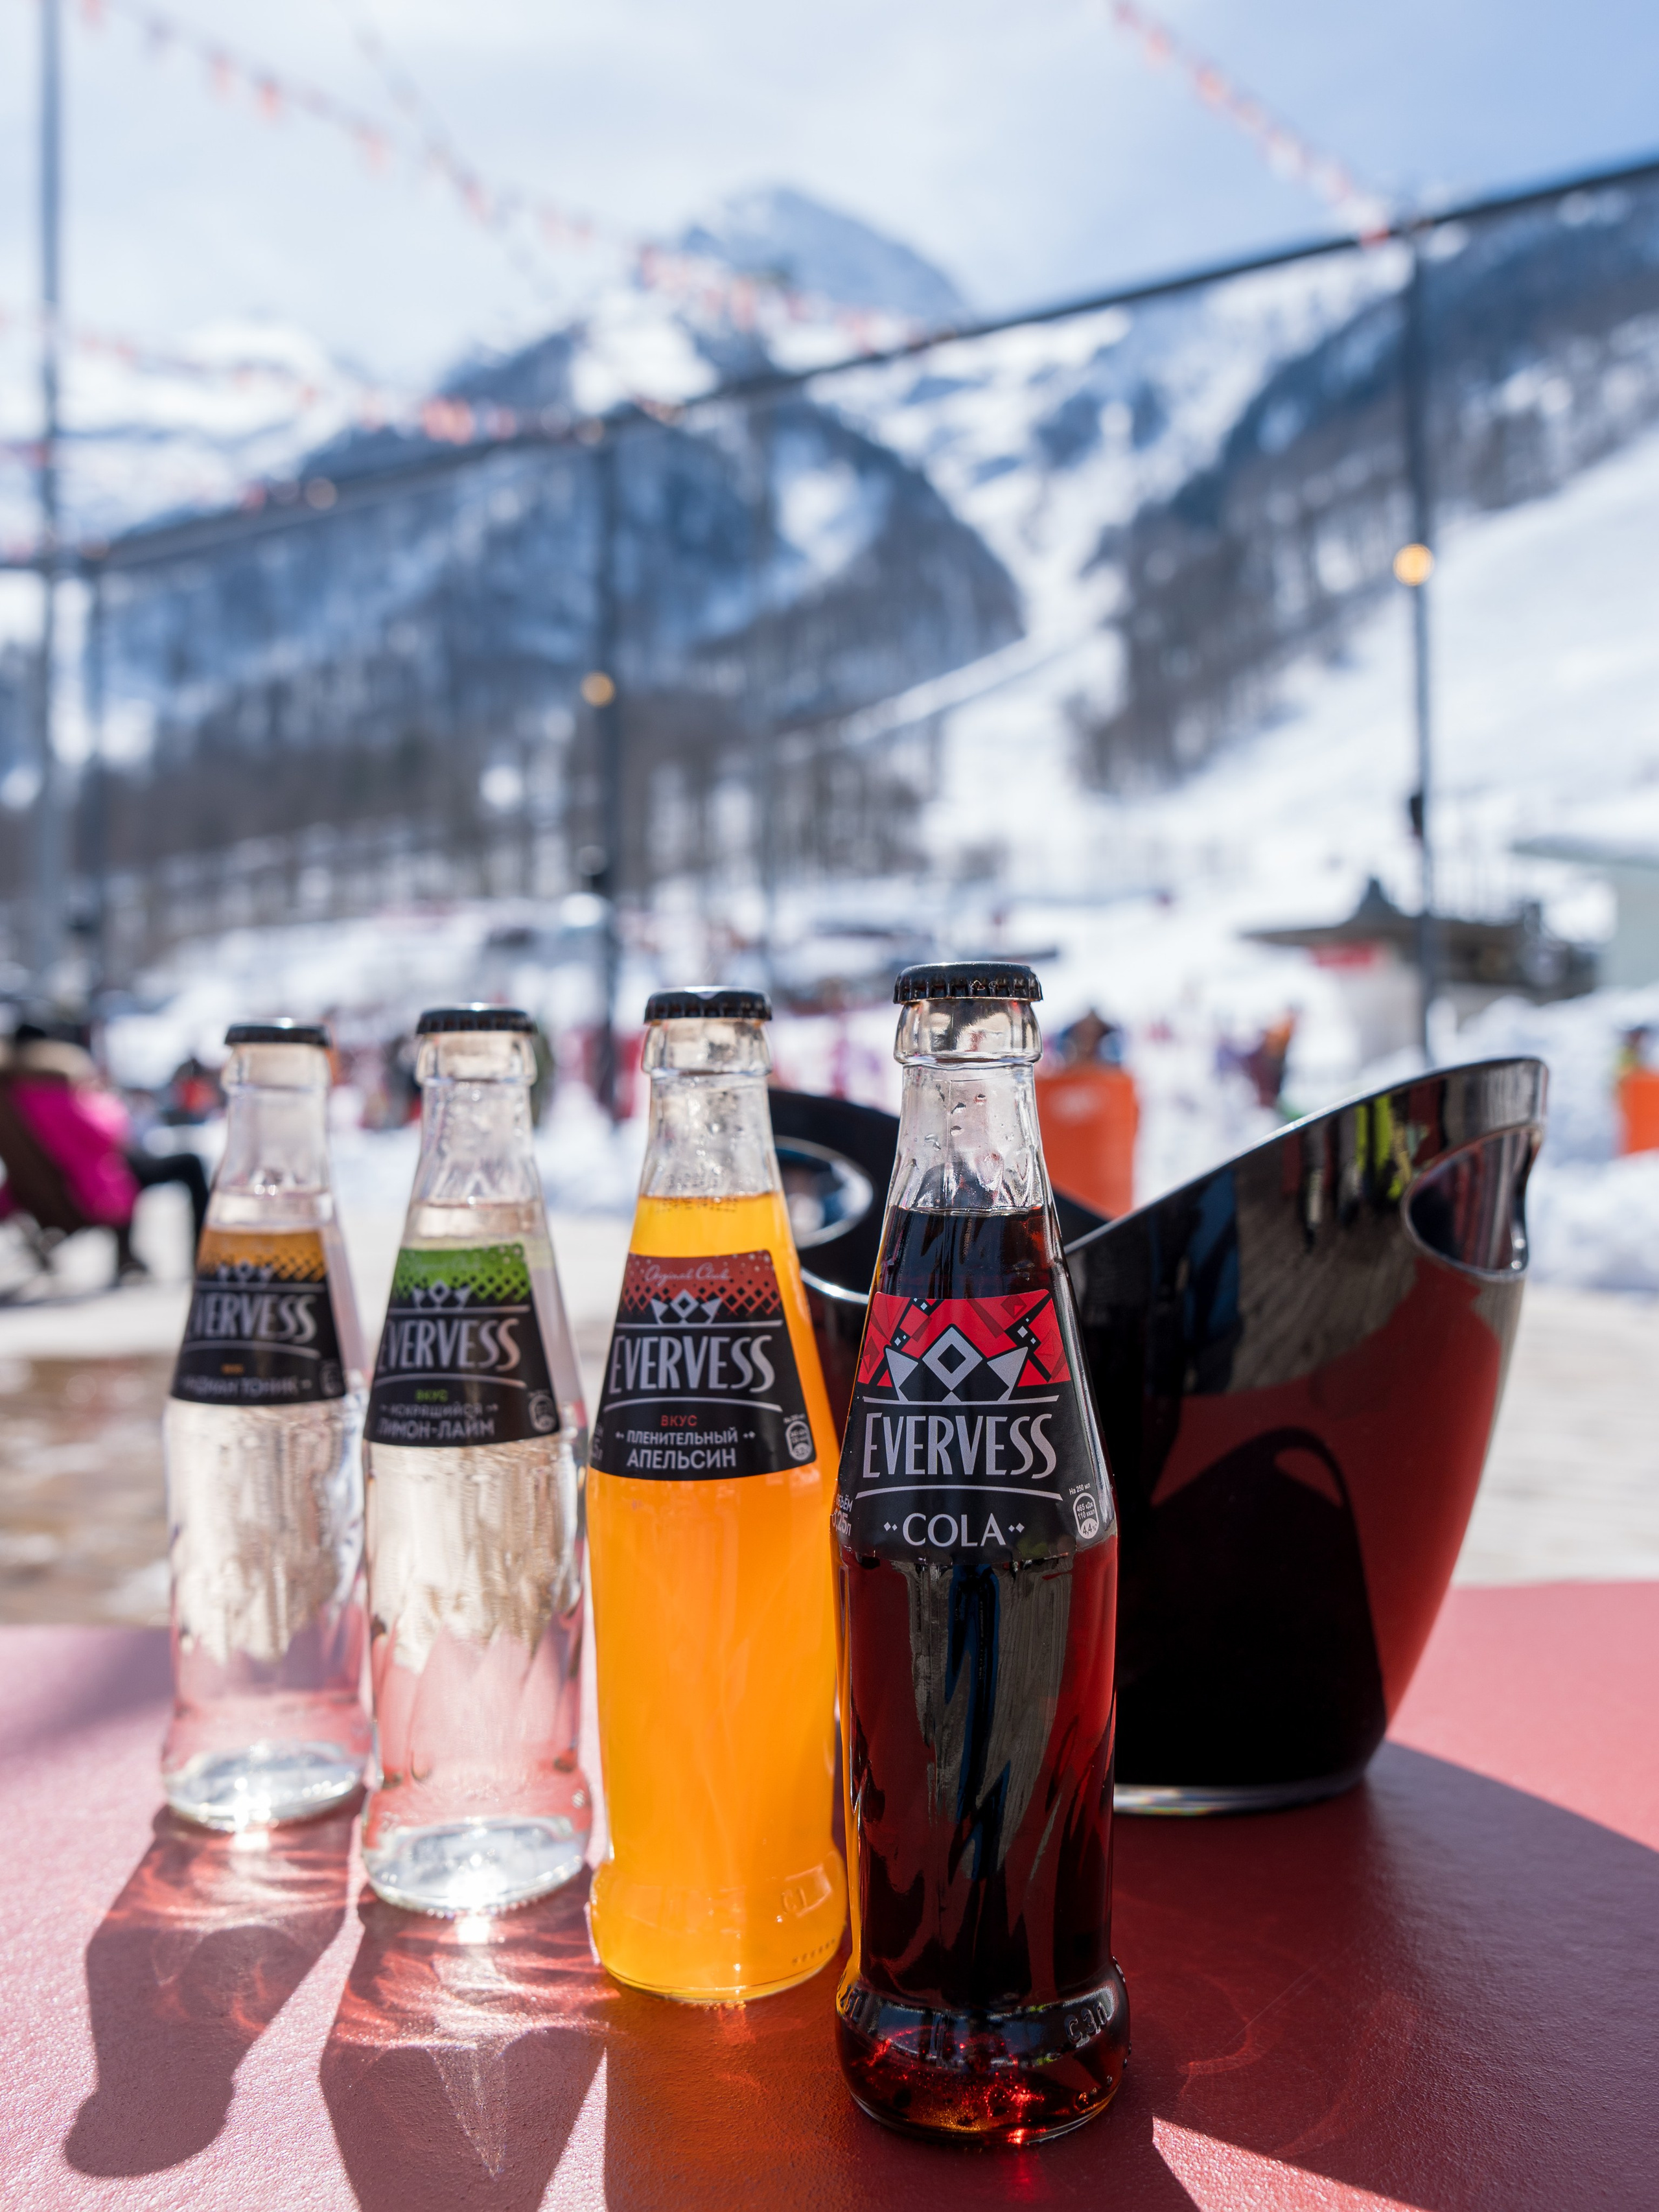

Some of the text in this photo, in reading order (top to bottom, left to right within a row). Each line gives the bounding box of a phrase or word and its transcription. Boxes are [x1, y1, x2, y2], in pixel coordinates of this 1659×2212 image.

[187, 1292, 317, 1344] VERVESS
[377, 1318, 521, 1373] EVERVESS
[609, 1334, 776, 1394] EVERVESS
[660, 1415, 698, 1426] ВКУС
[627, 1426, 738, 1445] ПЛЕНИТЕЛЬНЫЙ
[863, 1412, 1057, 1479] EVERVESS
[626, 1447, 737, 1470] АПЕЛЬСИН
[1076, 1484, 1084, 1493] 250
[1076, 1503, 1085, 1513] 465
[1078, 1511, 1086, 1520] 110
[903, 1513, 1006, 1548] COLA
